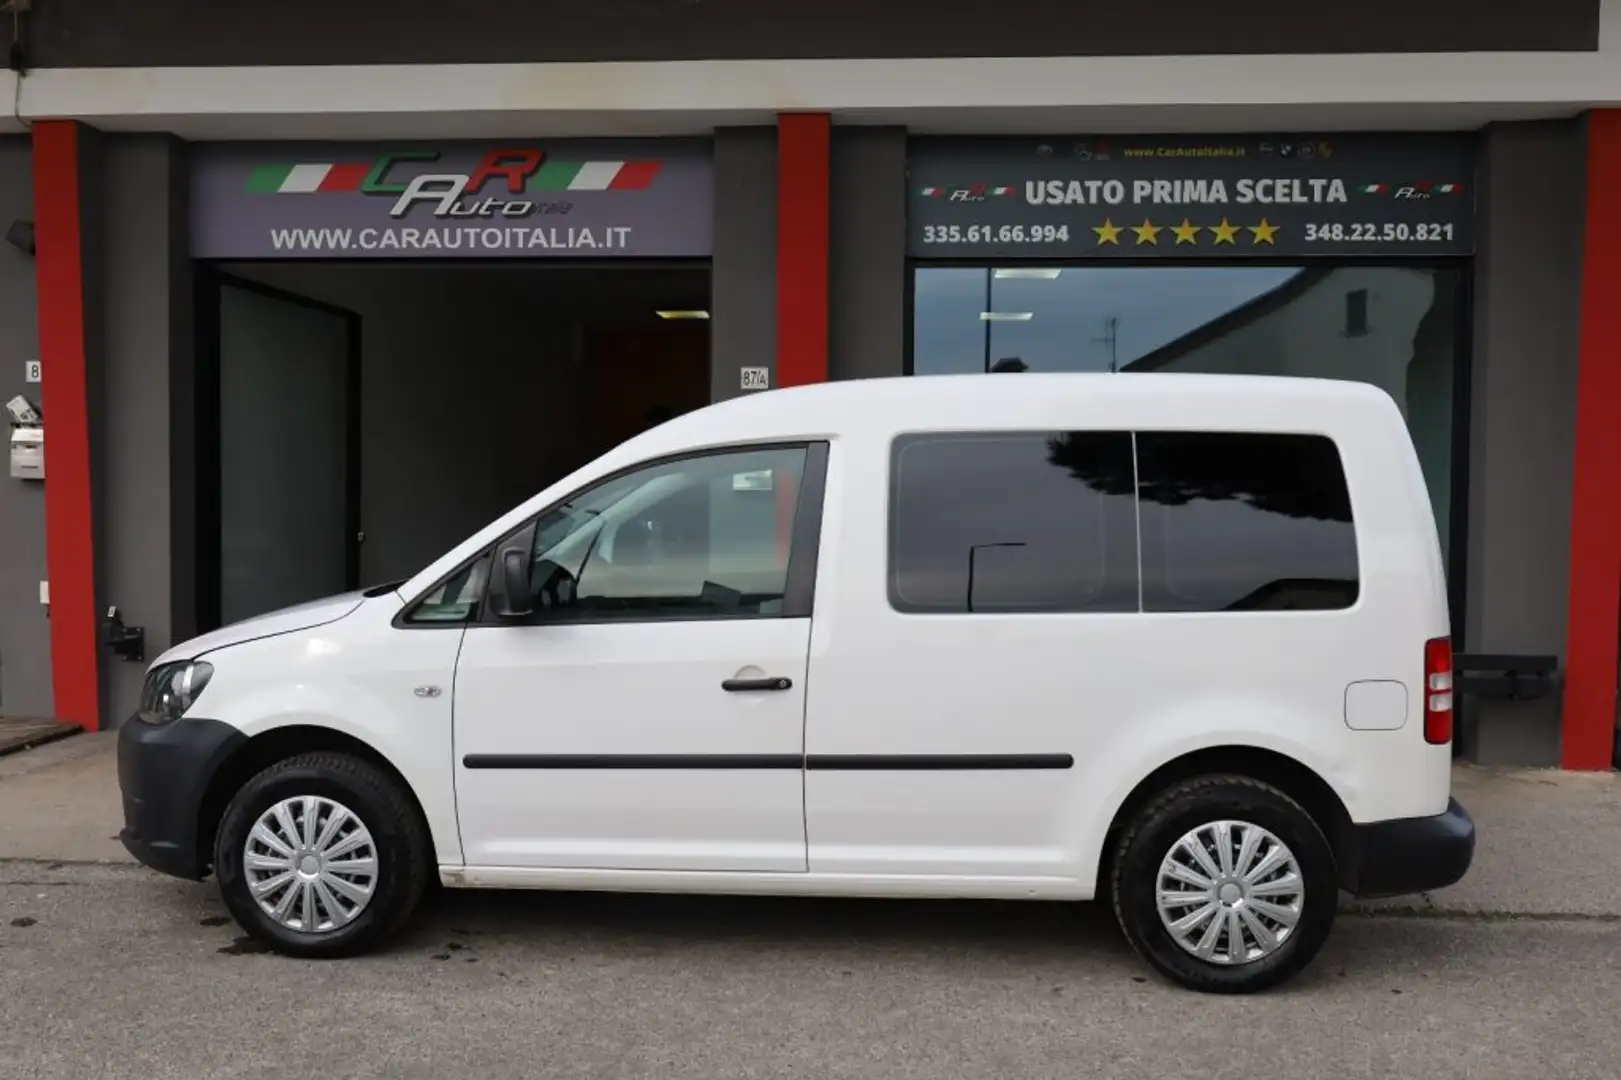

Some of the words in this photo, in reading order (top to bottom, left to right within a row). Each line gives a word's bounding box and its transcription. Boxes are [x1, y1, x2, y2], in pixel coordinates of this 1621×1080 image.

[1026, 180, 1125, 204] USATO
[1133, 178, 1227, 203] PRIMA
[1236, 177, 1347, 202] SCELTA
[271, 227, 631, 250] WWW.CARAUTOITALIA.IT
[923, 224, 1070, 244] 335.61.66.994
[1304, 222, 1454, 242] 348.22.50.821
